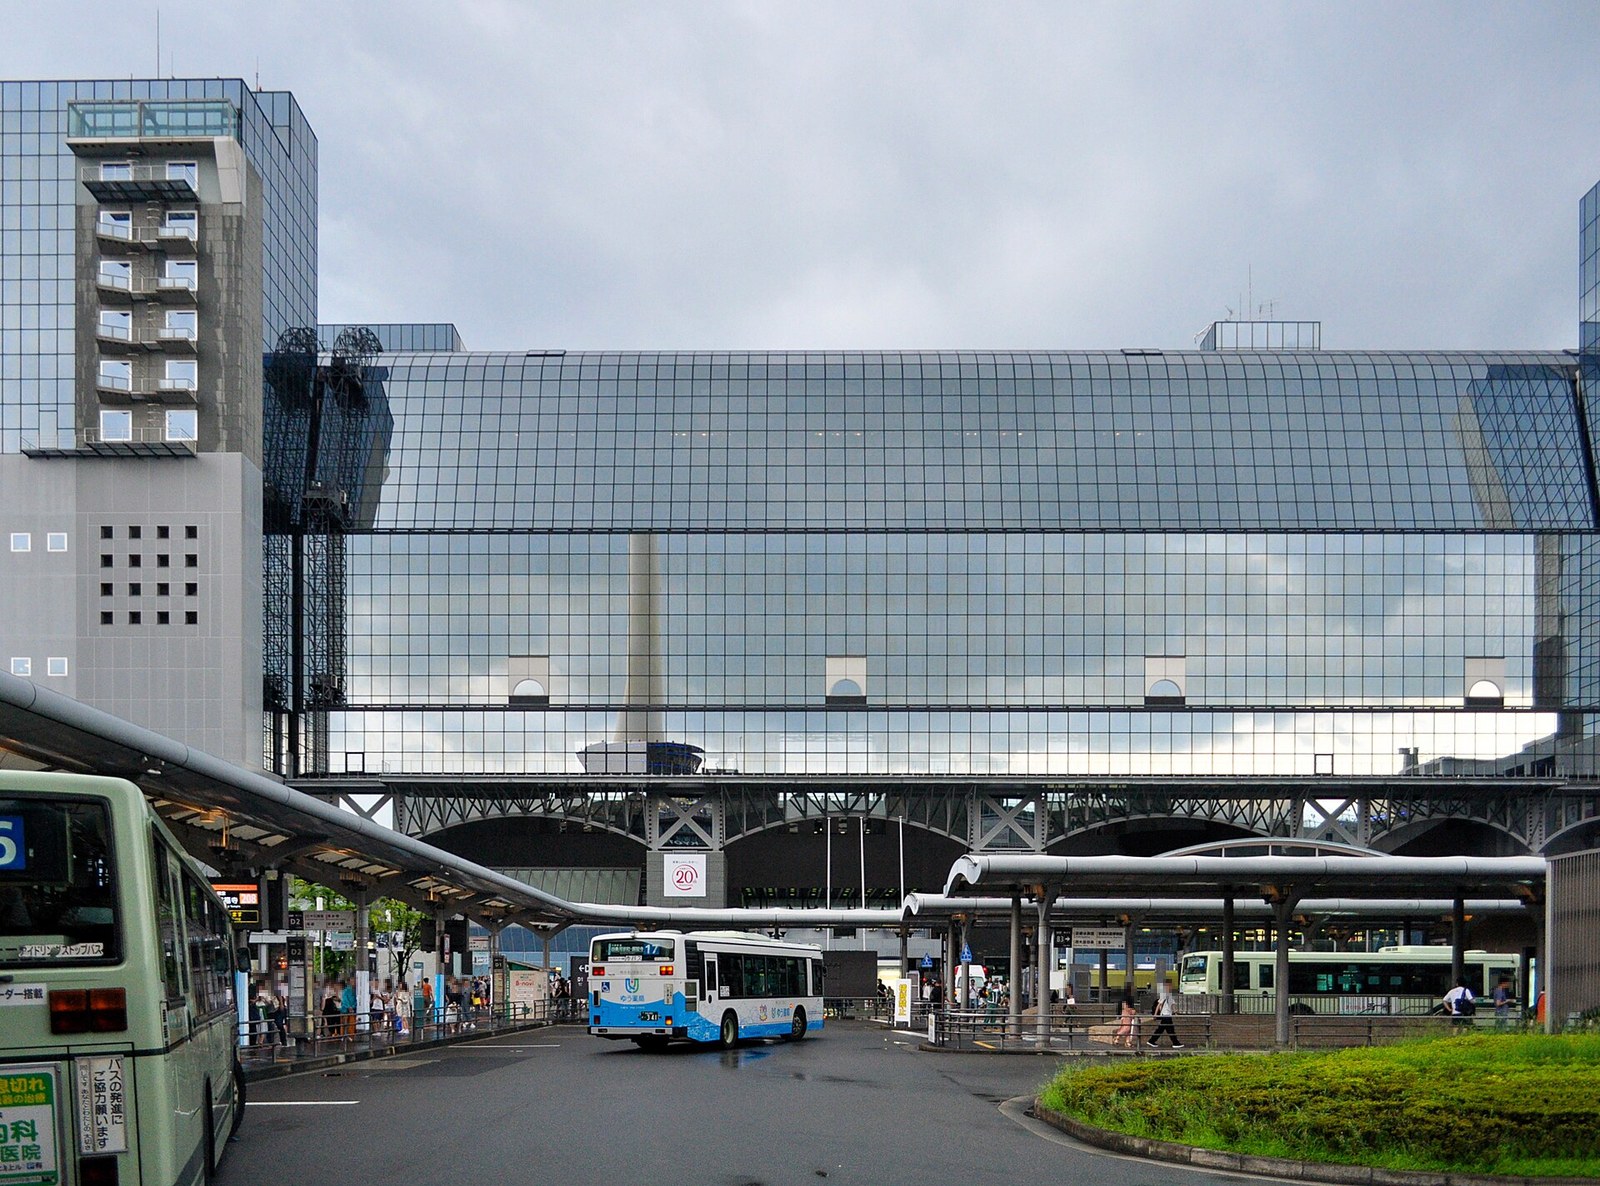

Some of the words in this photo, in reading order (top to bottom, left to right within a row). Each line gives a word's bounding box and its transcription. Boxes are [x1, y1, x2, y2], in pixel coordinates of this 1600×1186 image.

[676, 870, 693, 884] 20
[645, 945, 658, 954] 17
[108, 1059, 123, 1125] バスの発進に
[94, 1070, 109, 1149] ご協力願います
[0, 1144, 41, 1162] 医院
